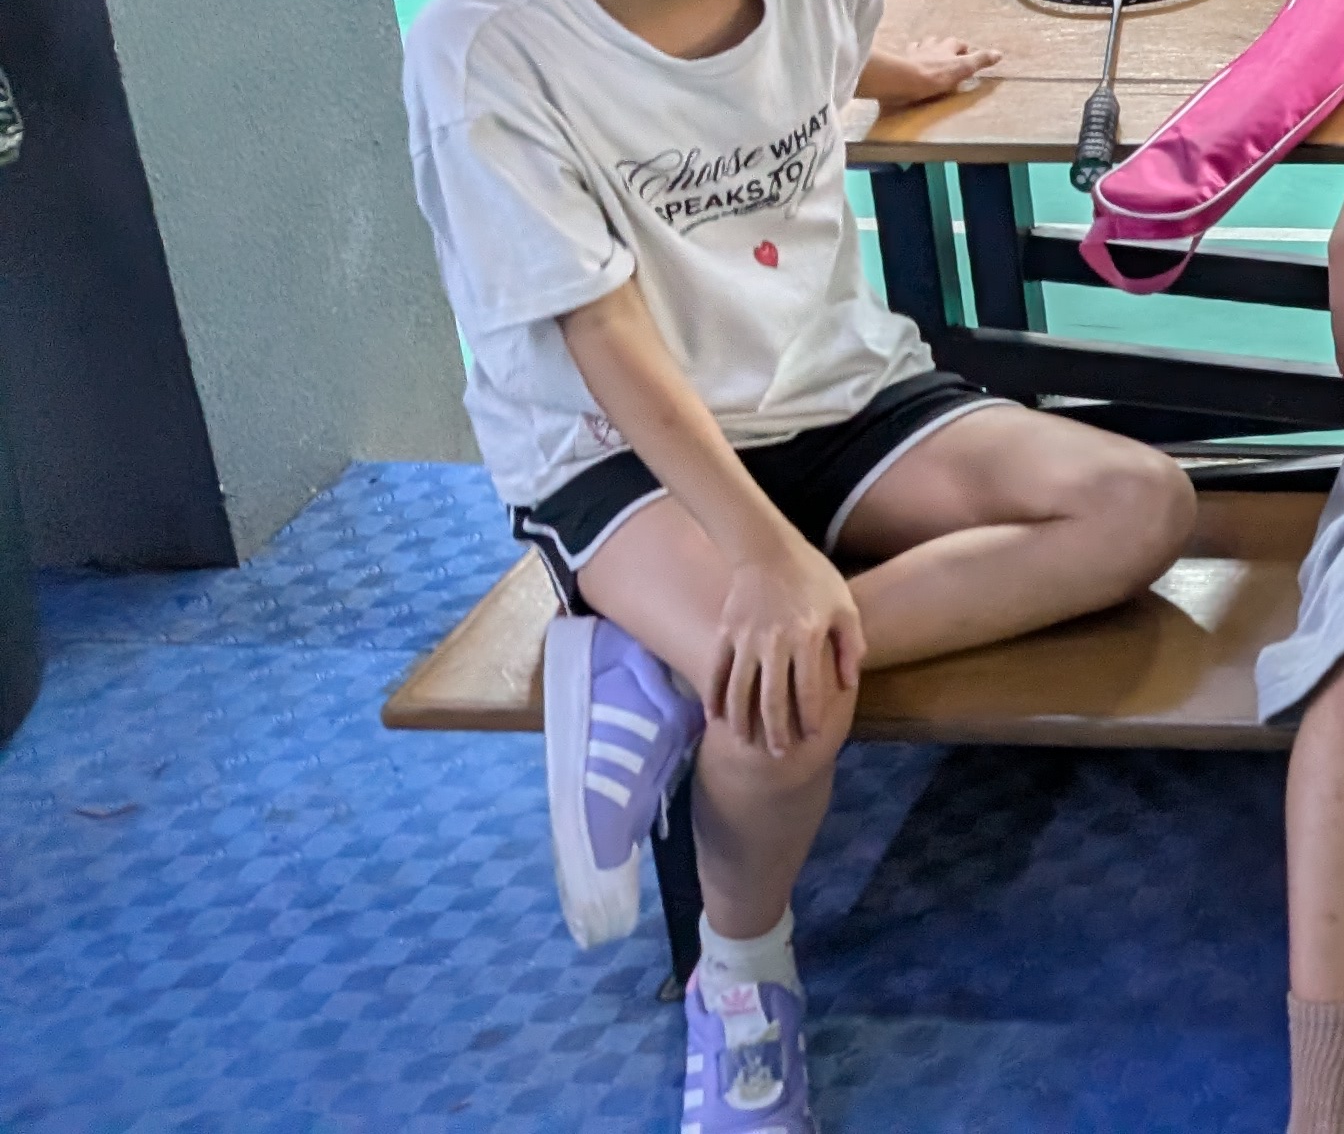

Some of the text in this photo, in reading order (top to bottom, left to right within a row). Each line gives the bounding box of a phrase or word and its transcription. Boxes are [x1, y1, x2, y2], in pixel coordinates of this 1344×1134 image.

[616, 146, 763, 202] Choose
[770, 104, 829, 159] WHAT
[769, 161, 804, 190] TO
